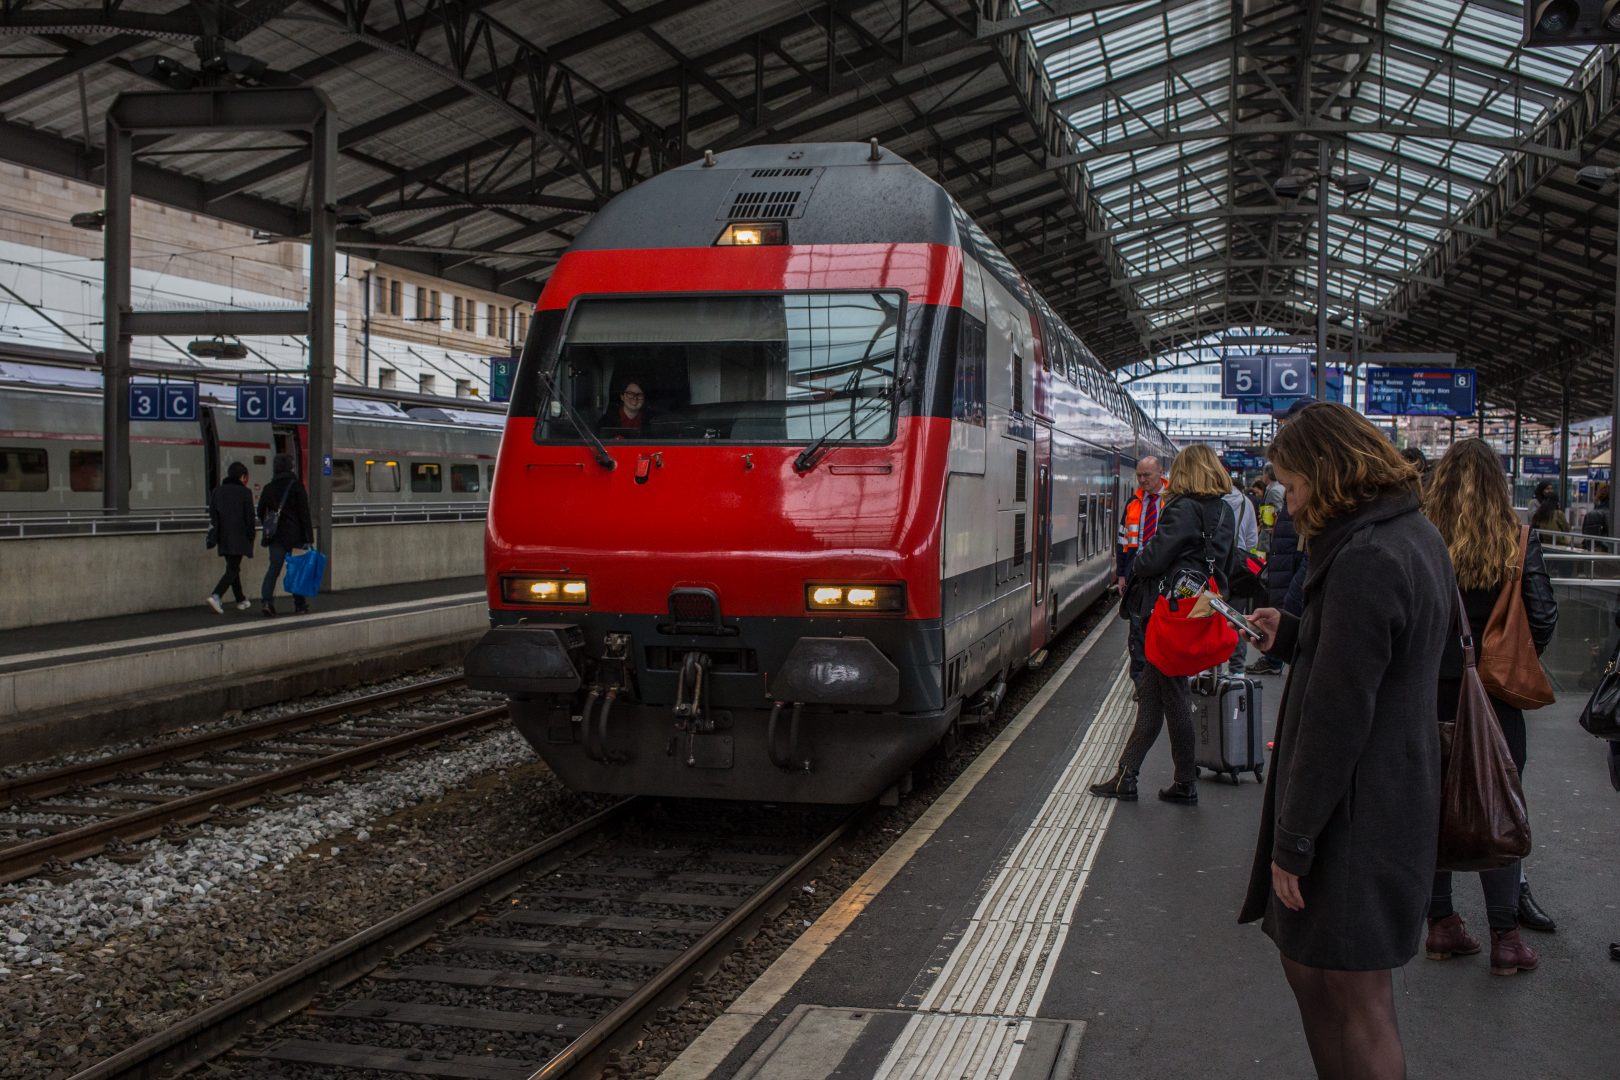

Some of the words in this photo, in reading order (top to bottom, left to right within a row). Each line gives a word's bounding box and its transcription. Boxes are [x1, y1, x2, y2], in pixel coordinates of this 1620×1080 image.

[499, 365, 506, 374] 3
[1236, 369, 1252, 391] 5
[1280, 369, 1298, 391] C
[1458, 376, 1466, 386] 6
[137, 396, 151, 414] 3
[173, 396, 187, 415] C
[247, 396, 261, 416] C
[282, 396, 296, 415] 4
